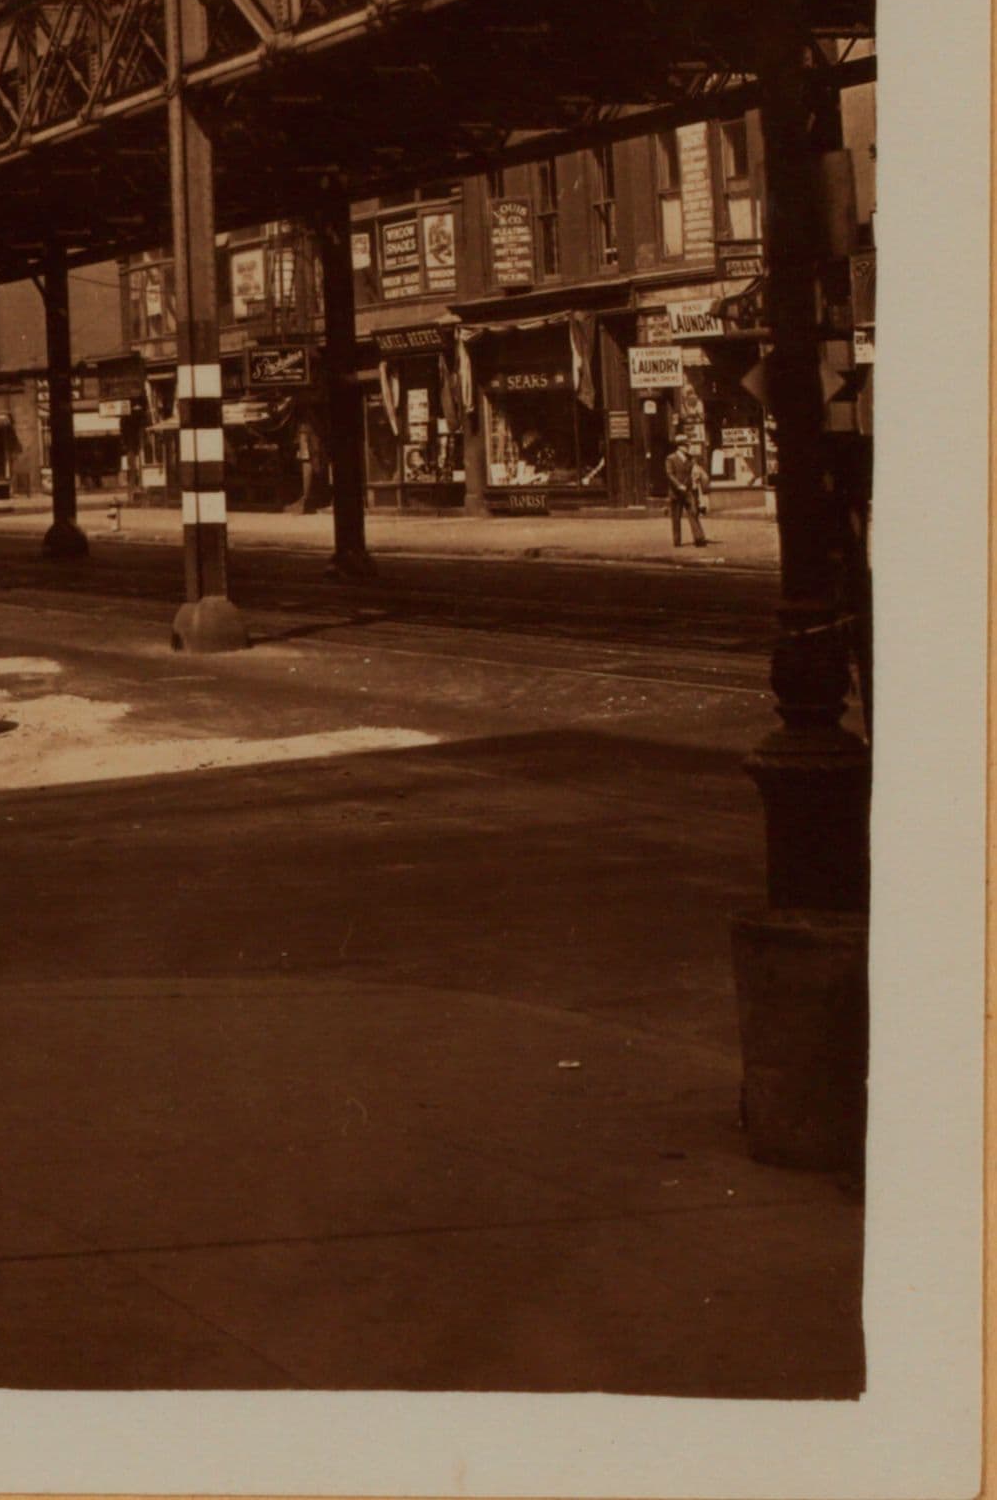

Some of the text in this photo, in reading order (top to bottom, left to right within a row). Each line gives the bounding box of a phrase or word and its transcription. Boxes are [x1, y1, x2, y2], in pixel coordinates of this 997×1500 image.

[669, 312, 720, 334] LAUNDRY
[632, 357, 680, 374] LAUNDRY
[506, 373, 548, 390] SEARS
